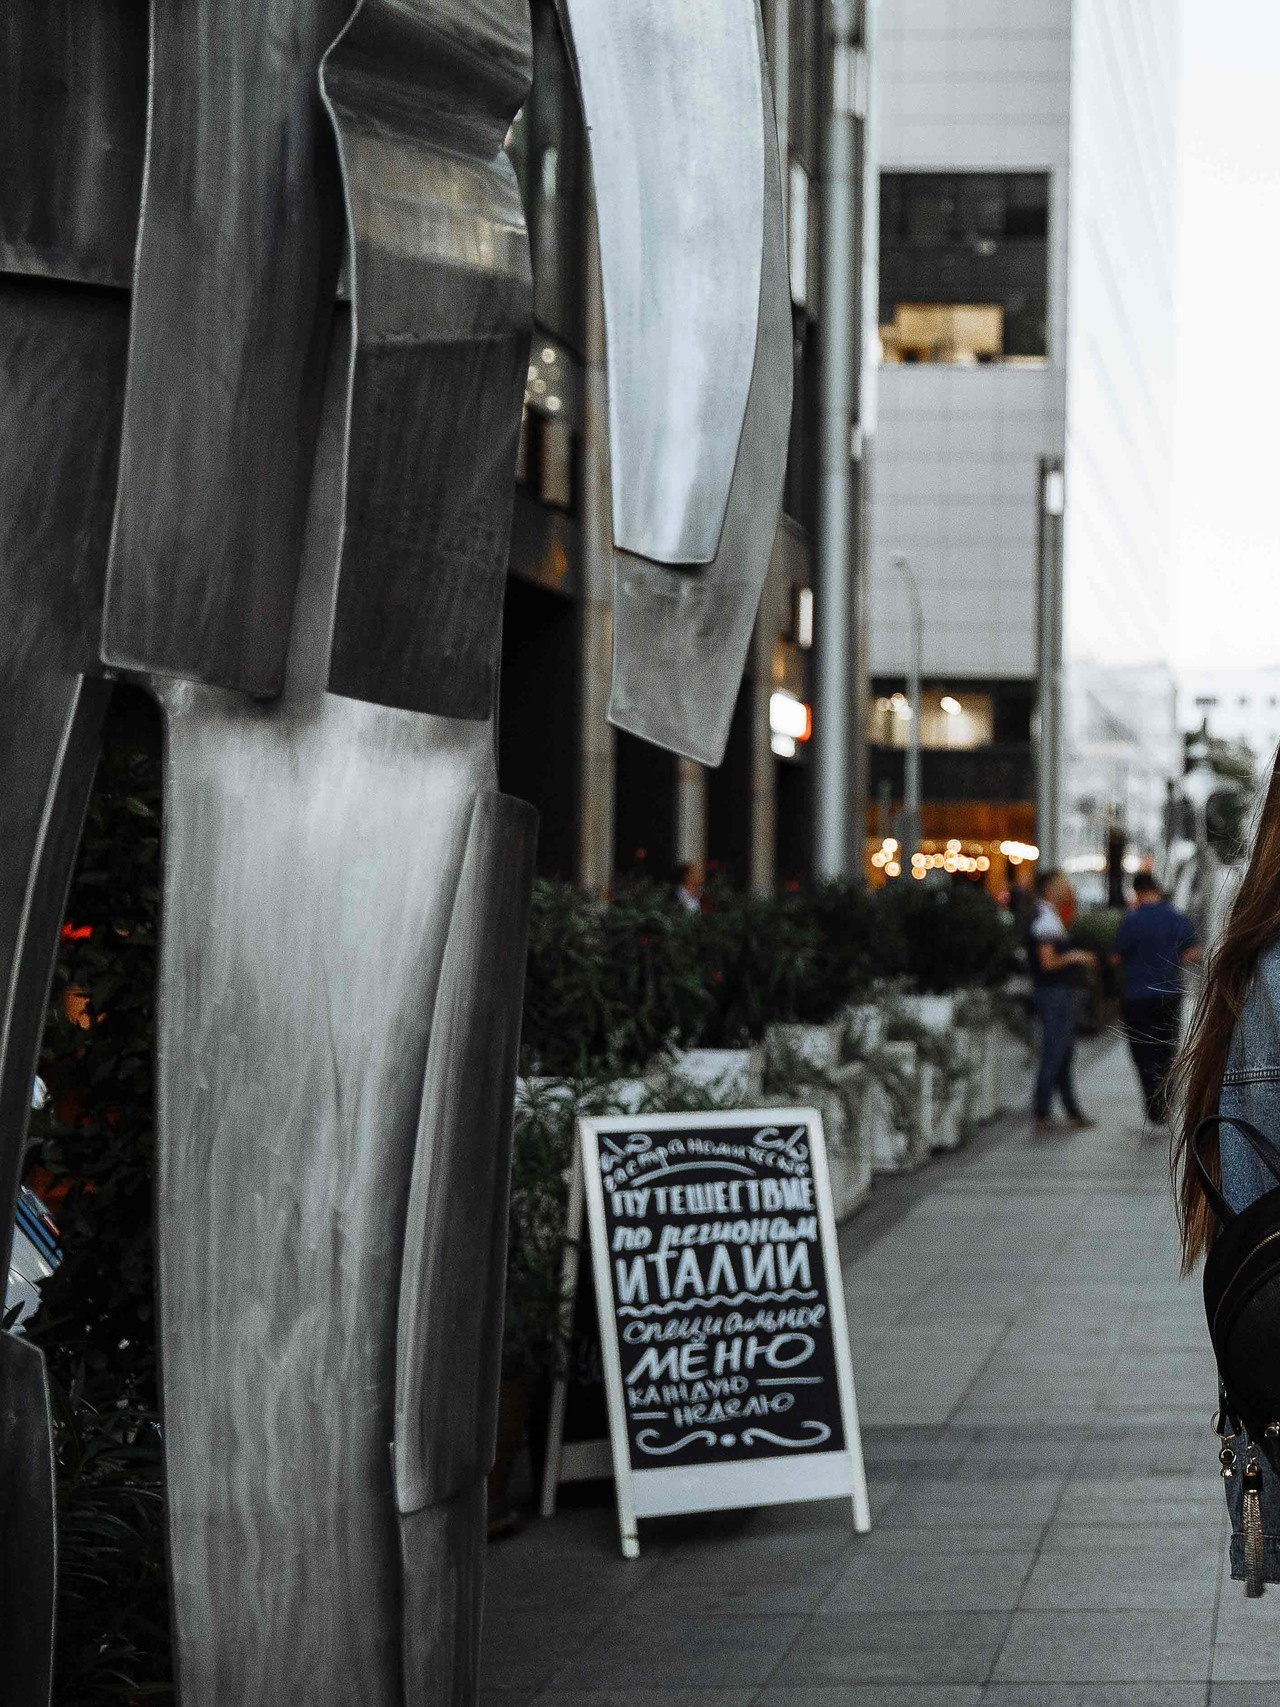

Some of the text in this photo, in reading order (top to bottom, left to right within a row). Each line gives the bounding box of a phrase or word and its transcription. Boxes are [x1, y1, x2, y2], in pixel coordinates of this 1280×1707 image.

[610, 1177, 816, 1218] ПУТЕШЕСТВИЕ
[611, 1215, 818, 1253] по регионам
[614, 1241, 812, 1304] ИТАЛИИ
[622, 1304, 826, 1345] специальное
[625, 1332, 816, 1386] МЕНЮ
[627, 1375, 749, 1409] КАЖДУЮ
